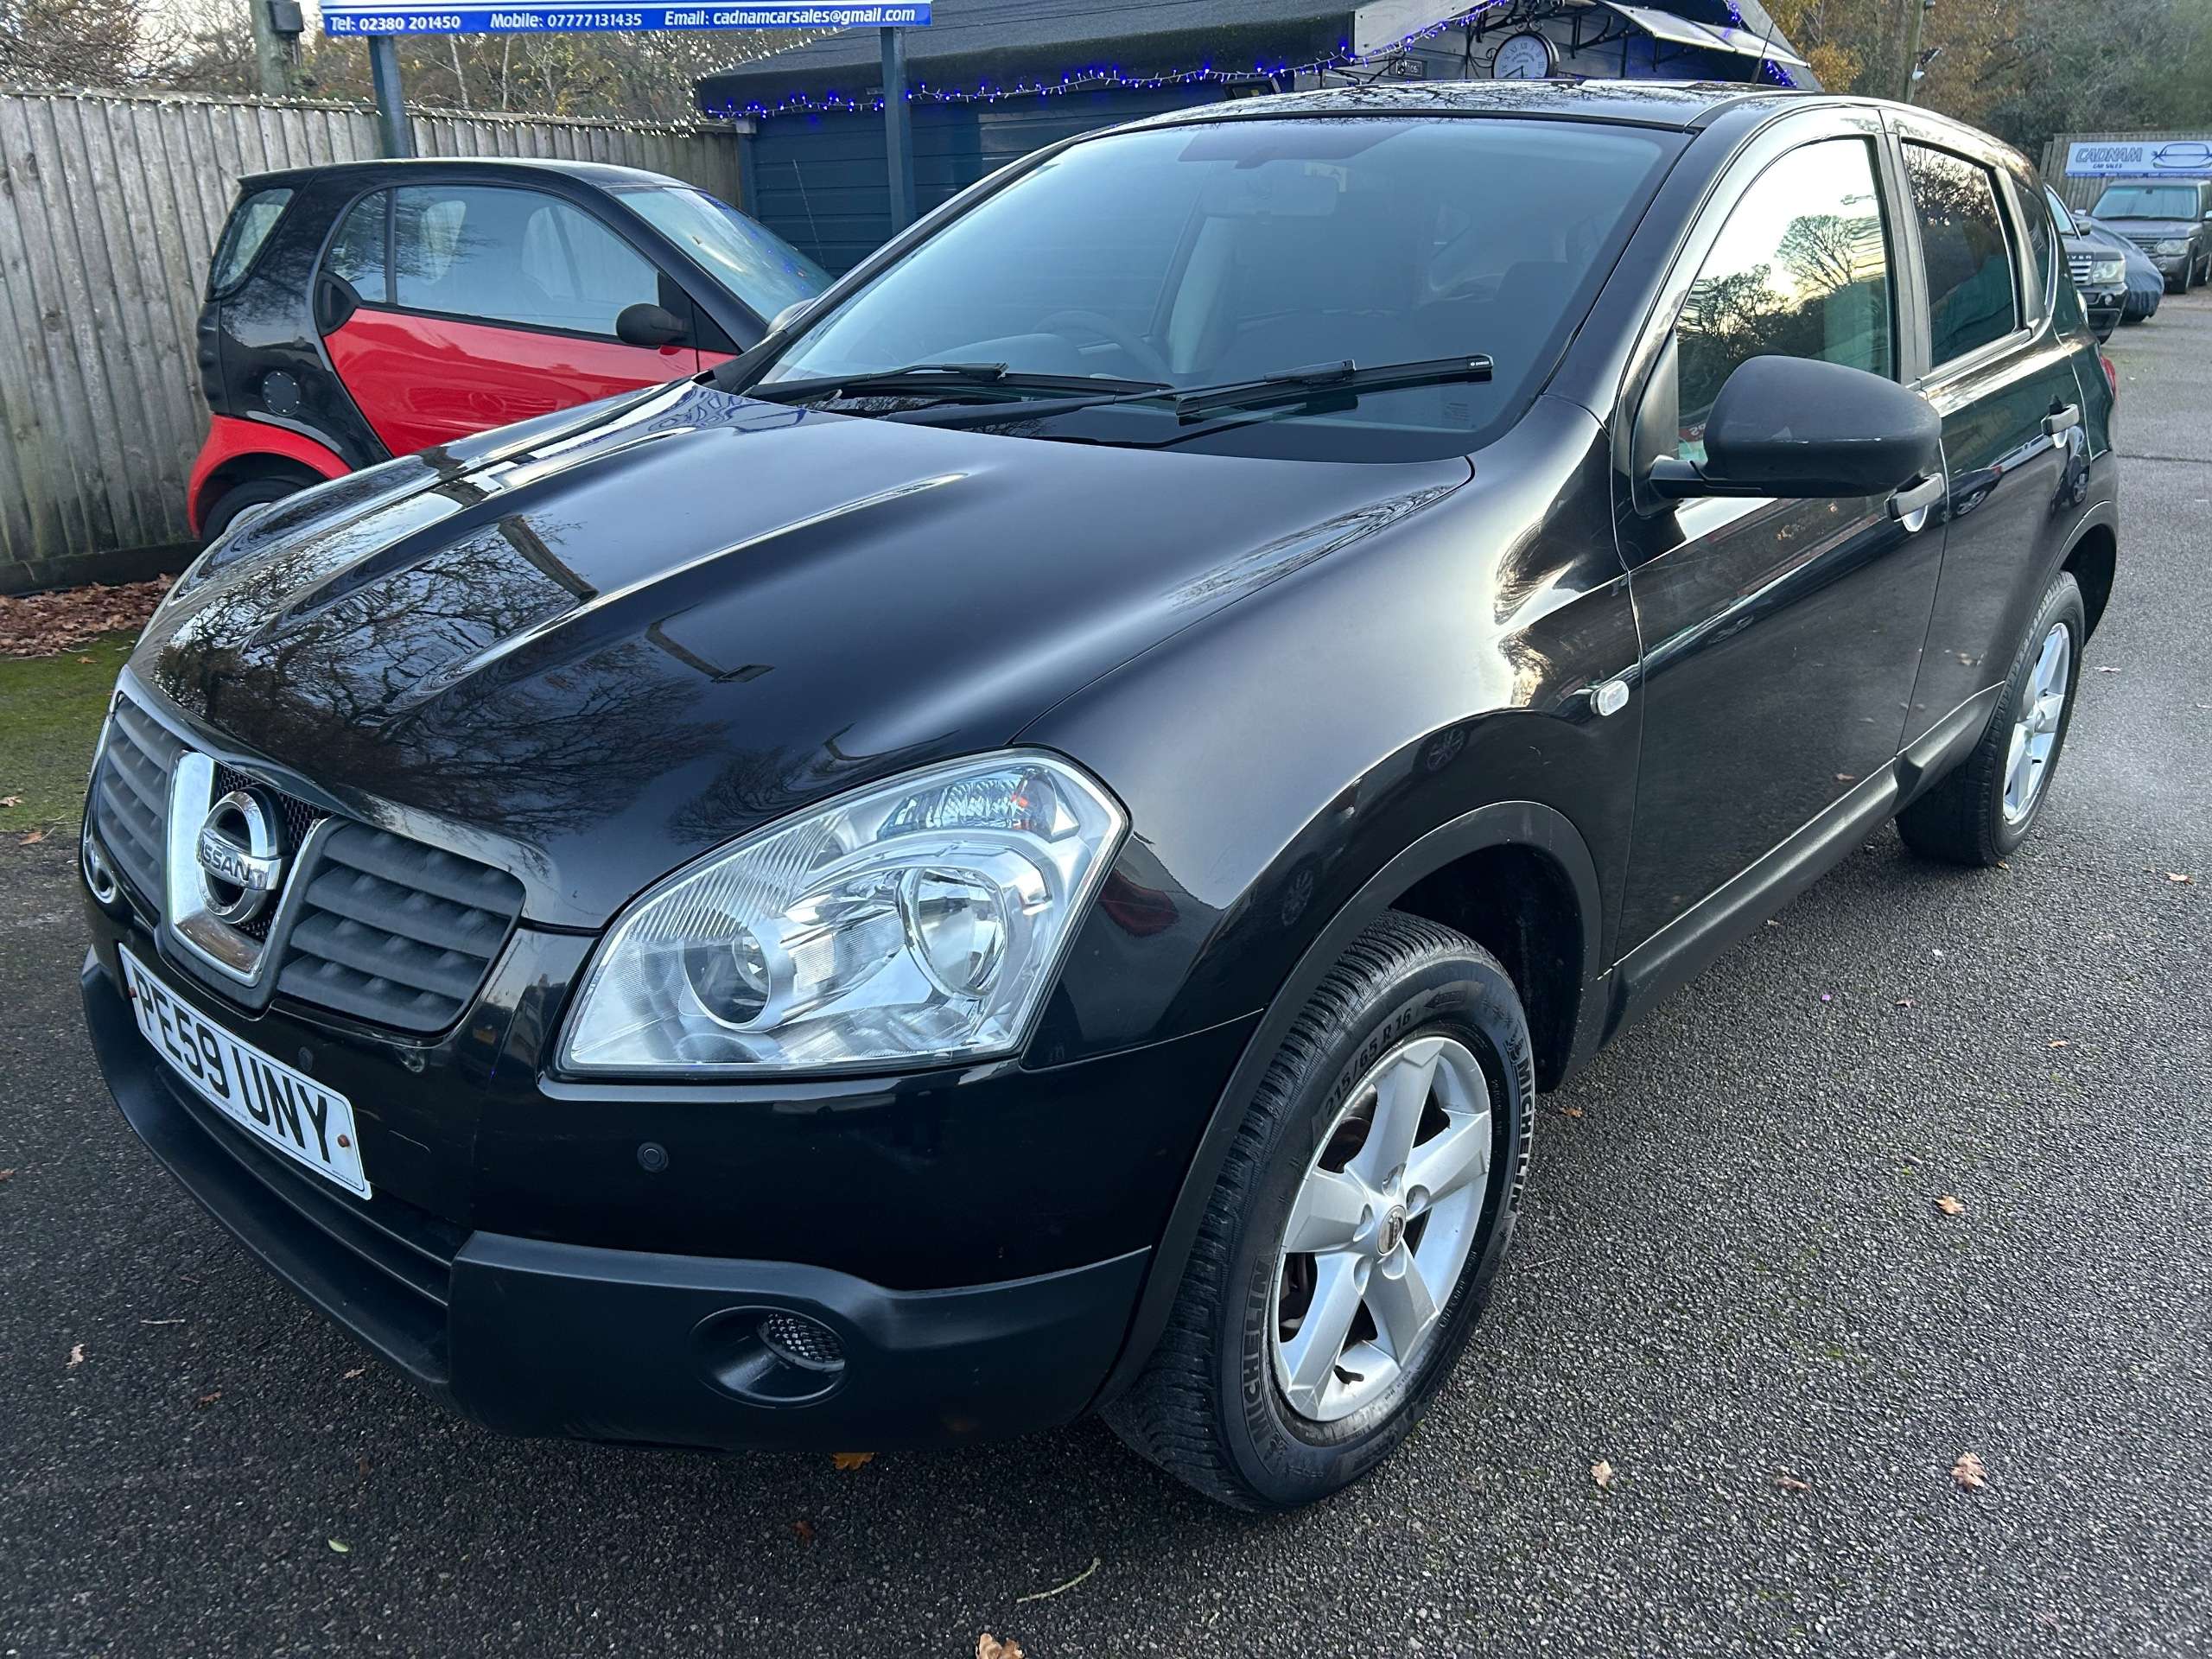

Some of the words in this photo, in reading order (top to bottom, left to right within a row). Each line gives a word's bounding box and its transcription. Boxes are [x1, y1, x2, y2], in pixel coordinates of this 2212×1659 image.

[330, 16, 355, 30] Tel:
[359, 17, 404, 30] 02380
[408, 16, 461, 29] 201450
[490, 13, 543, 29] Mobile:
[547, 13, 642, 28] 07777131435
[664, 10, 709, 26] Email:
[713, 8, 915, 25] cadnamcarsales@gmail.com
[2075, 147, 2143, 162] CADNAM
[132, 965, 230, 1099] PE59
[232, 1044, 331, 1165] UNY
[1325, 1038, 1379, 1116] 215/65
[1382, 1023, 1392, 1044] R
[1395, 1007, 1412, 1031] 16
[1242, 1256, 1274, 1446] MICHELIN
